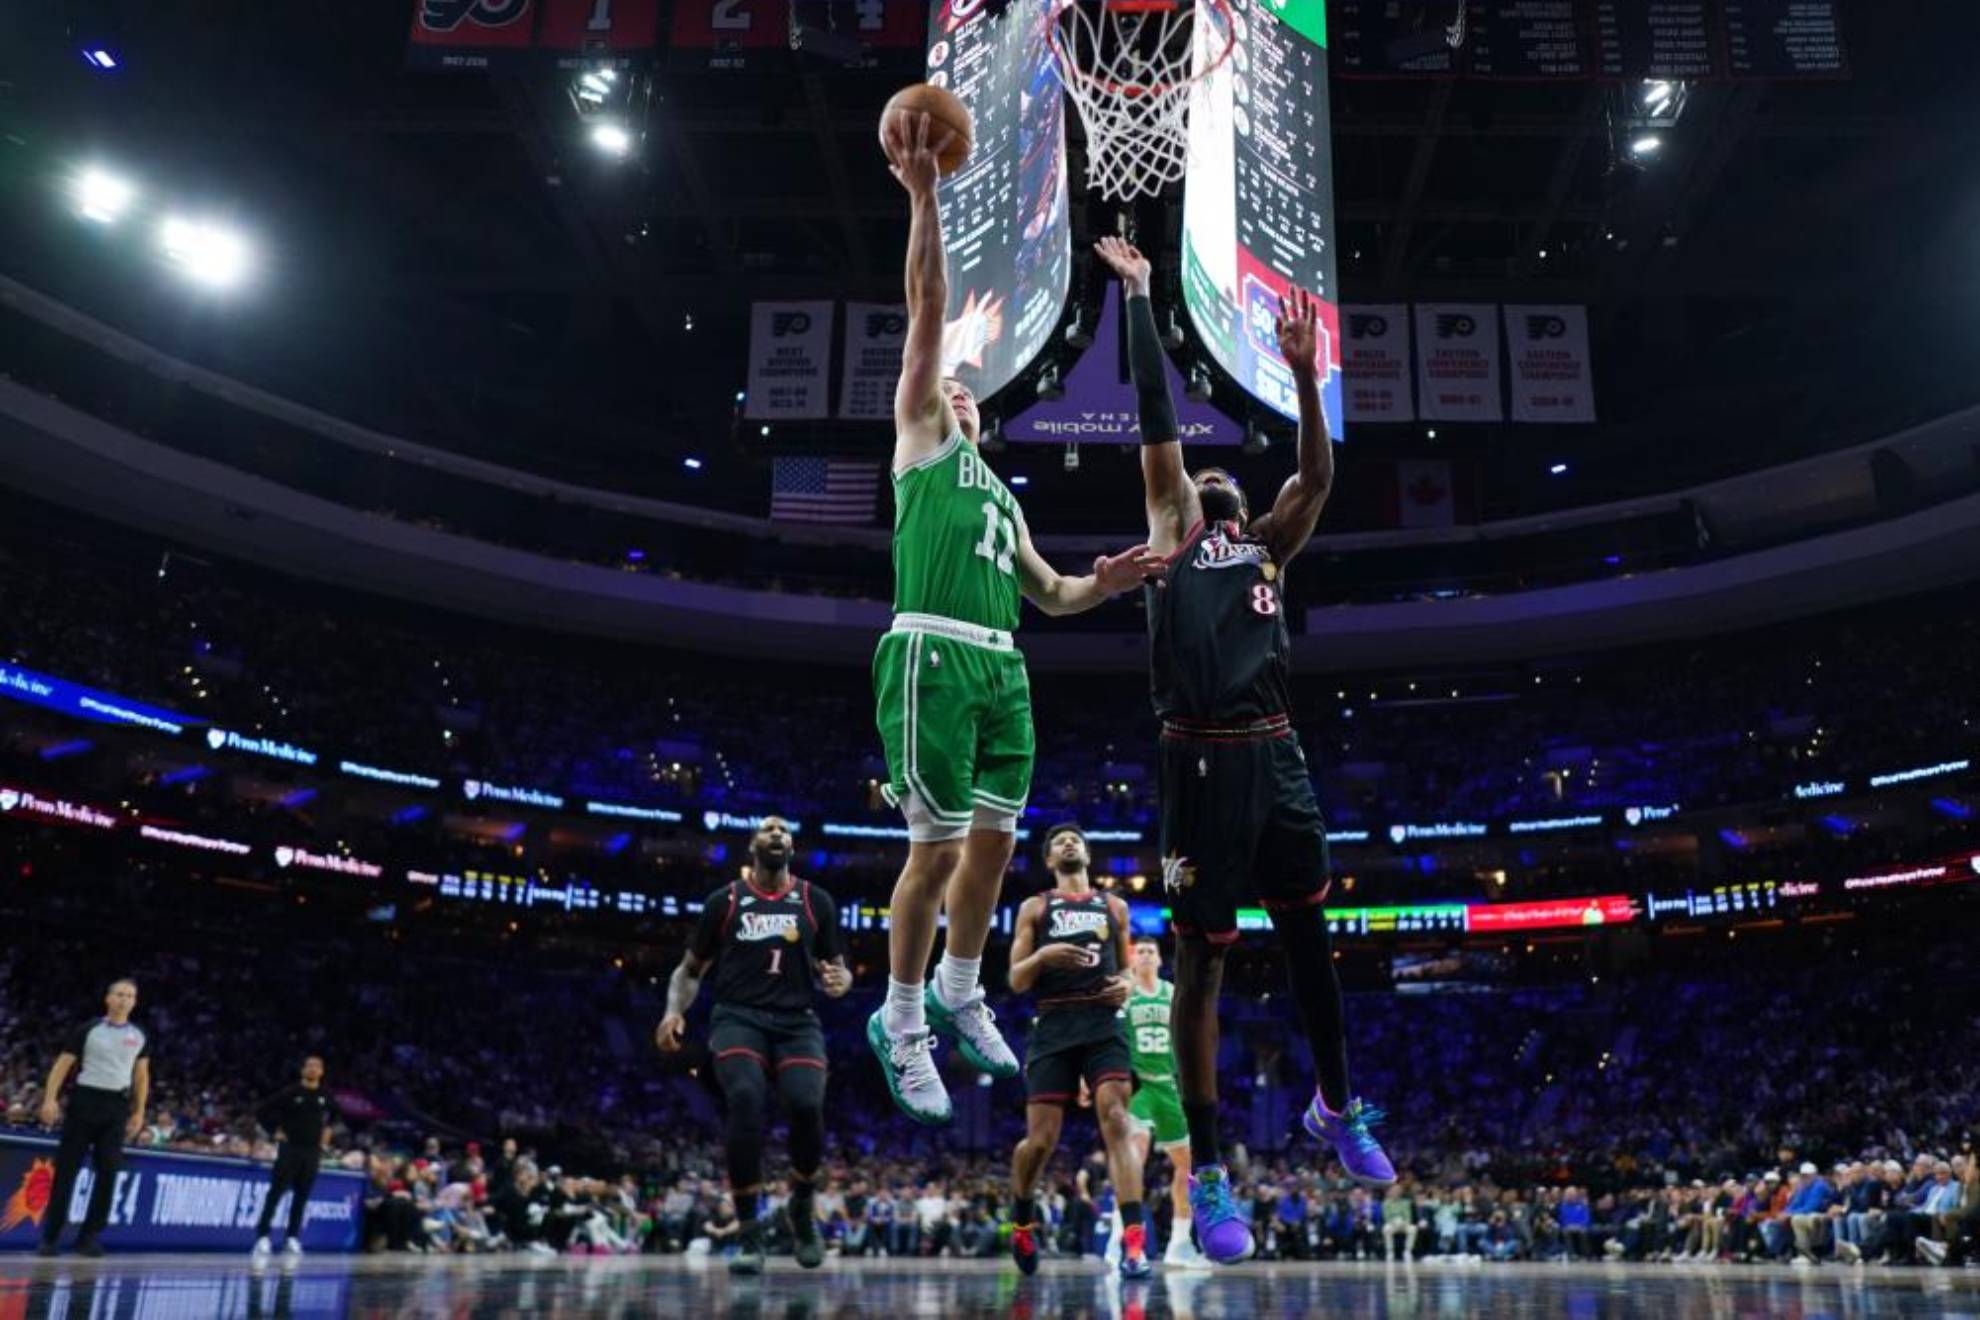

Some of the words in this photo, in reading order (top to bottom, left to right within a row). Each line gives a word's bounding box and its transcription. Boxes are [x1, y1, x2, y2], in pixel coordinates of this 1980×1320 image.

[1033, 420, 1121, 434] mobile
[1252, 584, 1276, 615] 8
[767, 949, 782, 974] 1
[1136, 1026, 1170, 1053] 52
